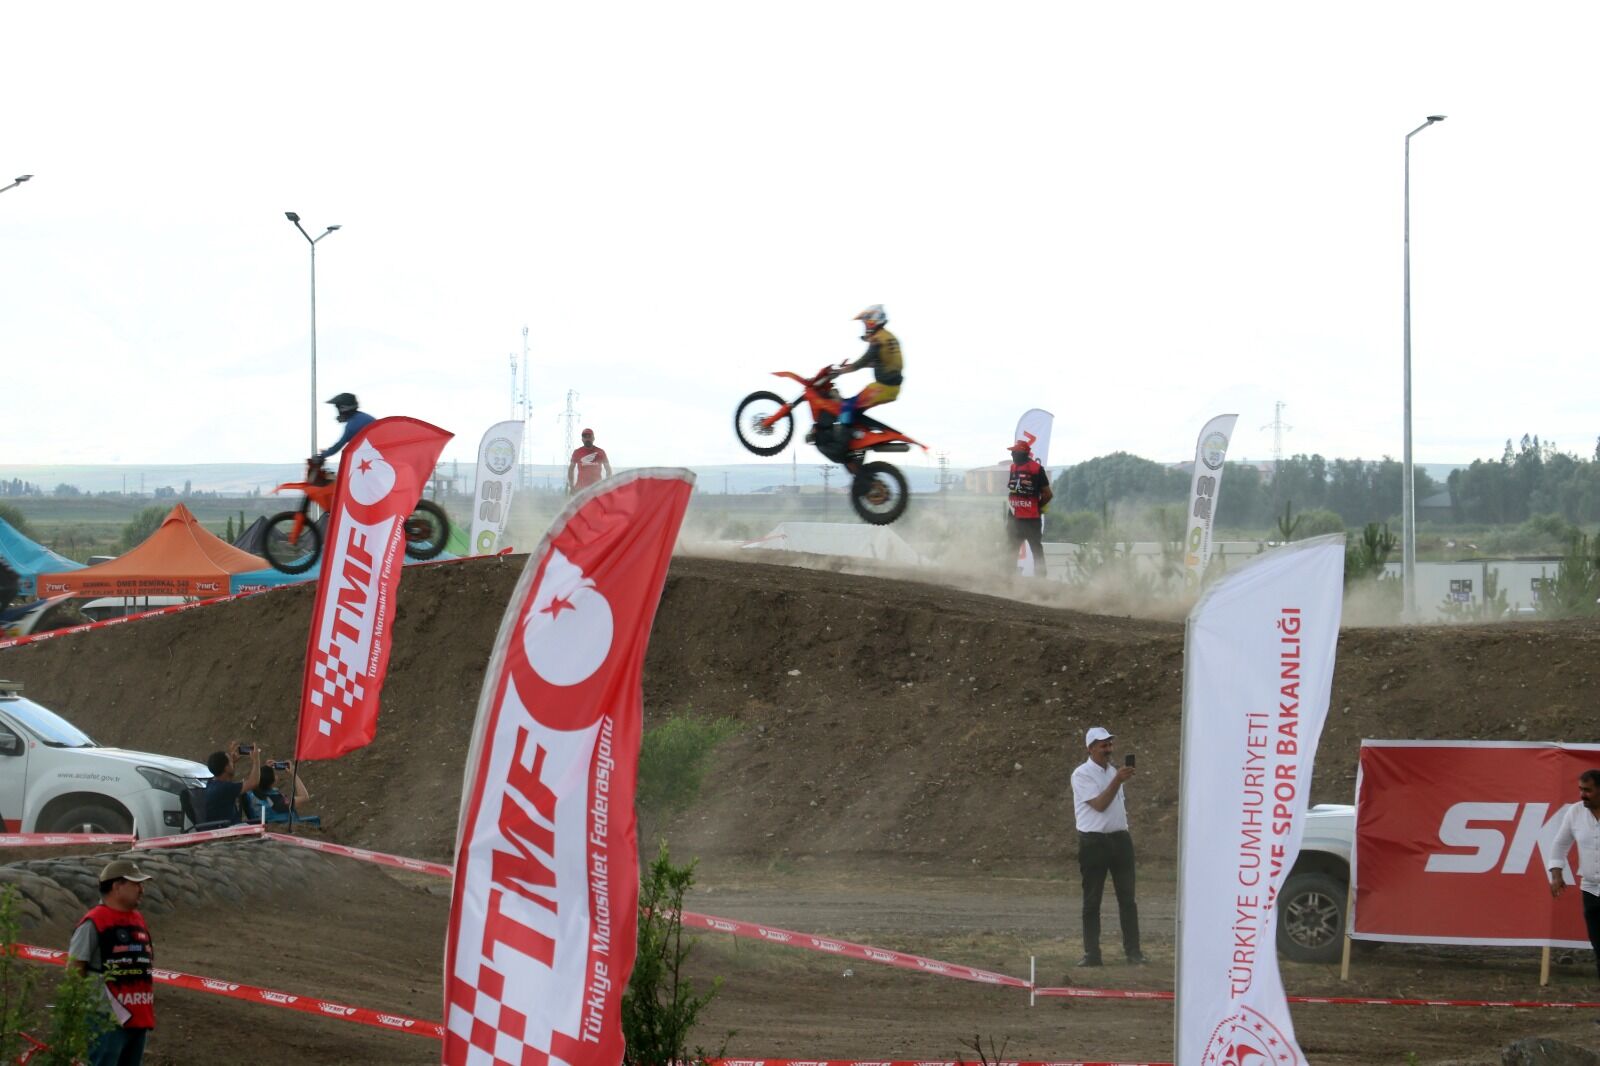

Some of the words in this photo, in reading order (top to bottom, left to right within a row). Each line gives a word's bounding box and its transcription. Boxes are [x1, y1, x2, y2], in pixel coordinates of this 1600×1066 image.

[479, 480, 503, 523] 23
[331, 526, 373, 644] TMF
[368, 639, 382, 678] Türkiye
[375, 582, 388, 637] Motosiklet
[1276, 608, 1301, 755] BAKANLIĞI
[590, 715, 615, 848] Federasyonu
[1239, 713, 1269, 887] CUMHURİYETİ
[1271, 764, 1297, 836] SPOR
[481, 724, 558, 970] TMF
[590, 852, 611, 956] Motosiklet
[1228, 895, 1258, 999] TÜRKİYE
[583, 961, 612, 1043] Türkiye
